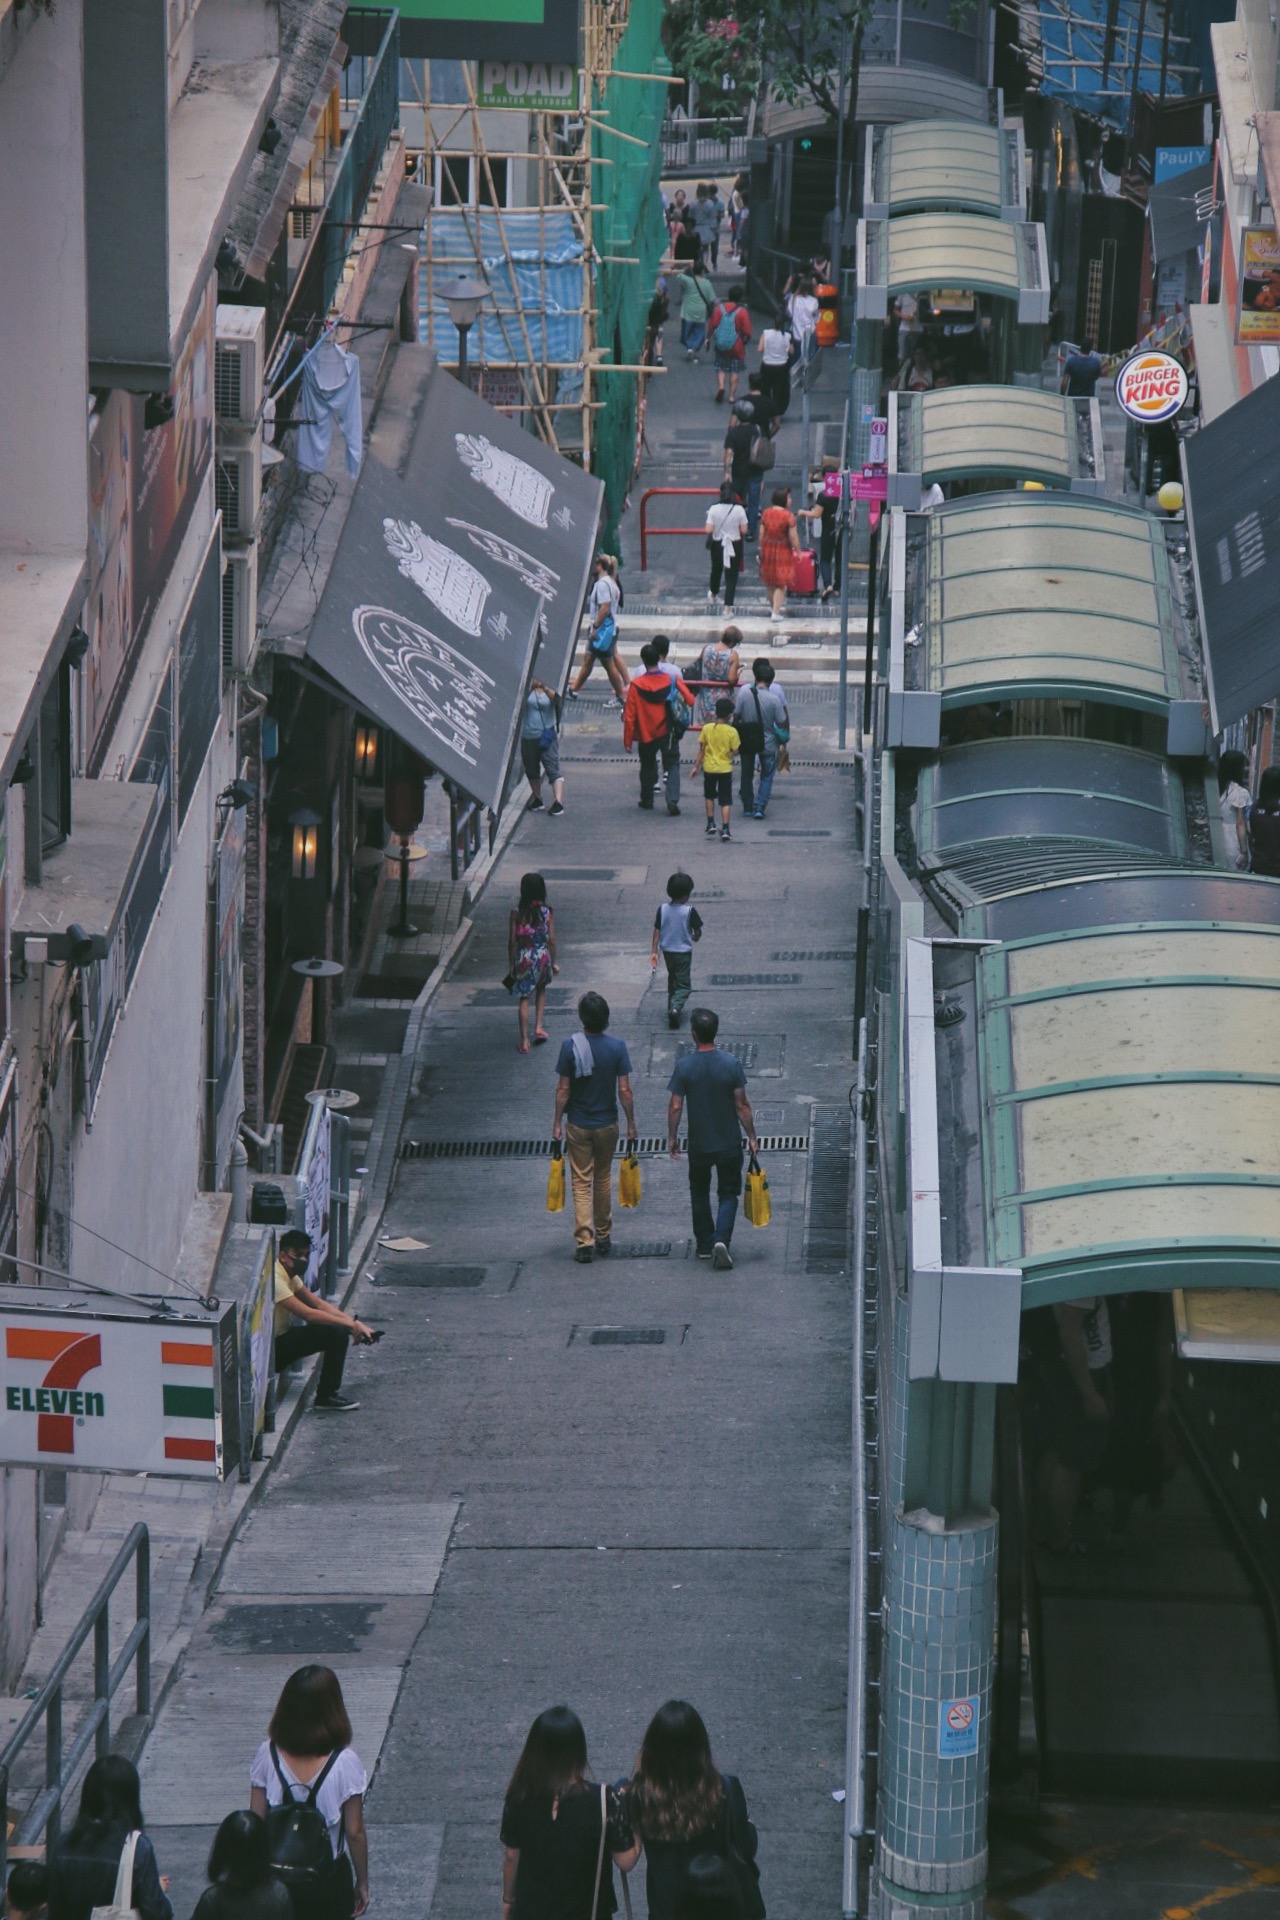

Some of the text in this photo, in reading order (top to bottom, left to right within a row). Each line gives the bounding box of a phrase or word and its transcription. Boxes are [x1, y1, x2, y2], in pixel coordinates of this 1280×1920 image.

[483, 61, 573, 96] POAD
[483, 95, 573, 106] SMARTER OUTDOOR
[1159, 150, 1207, 165] Paul Y
[1125, 368, 1180, 387] BURGER
[1125, 380, 1181, 404] KING
[372, 622, 456, 723] PEAK CAFE
[6, 1327, 102, 1455] 7
